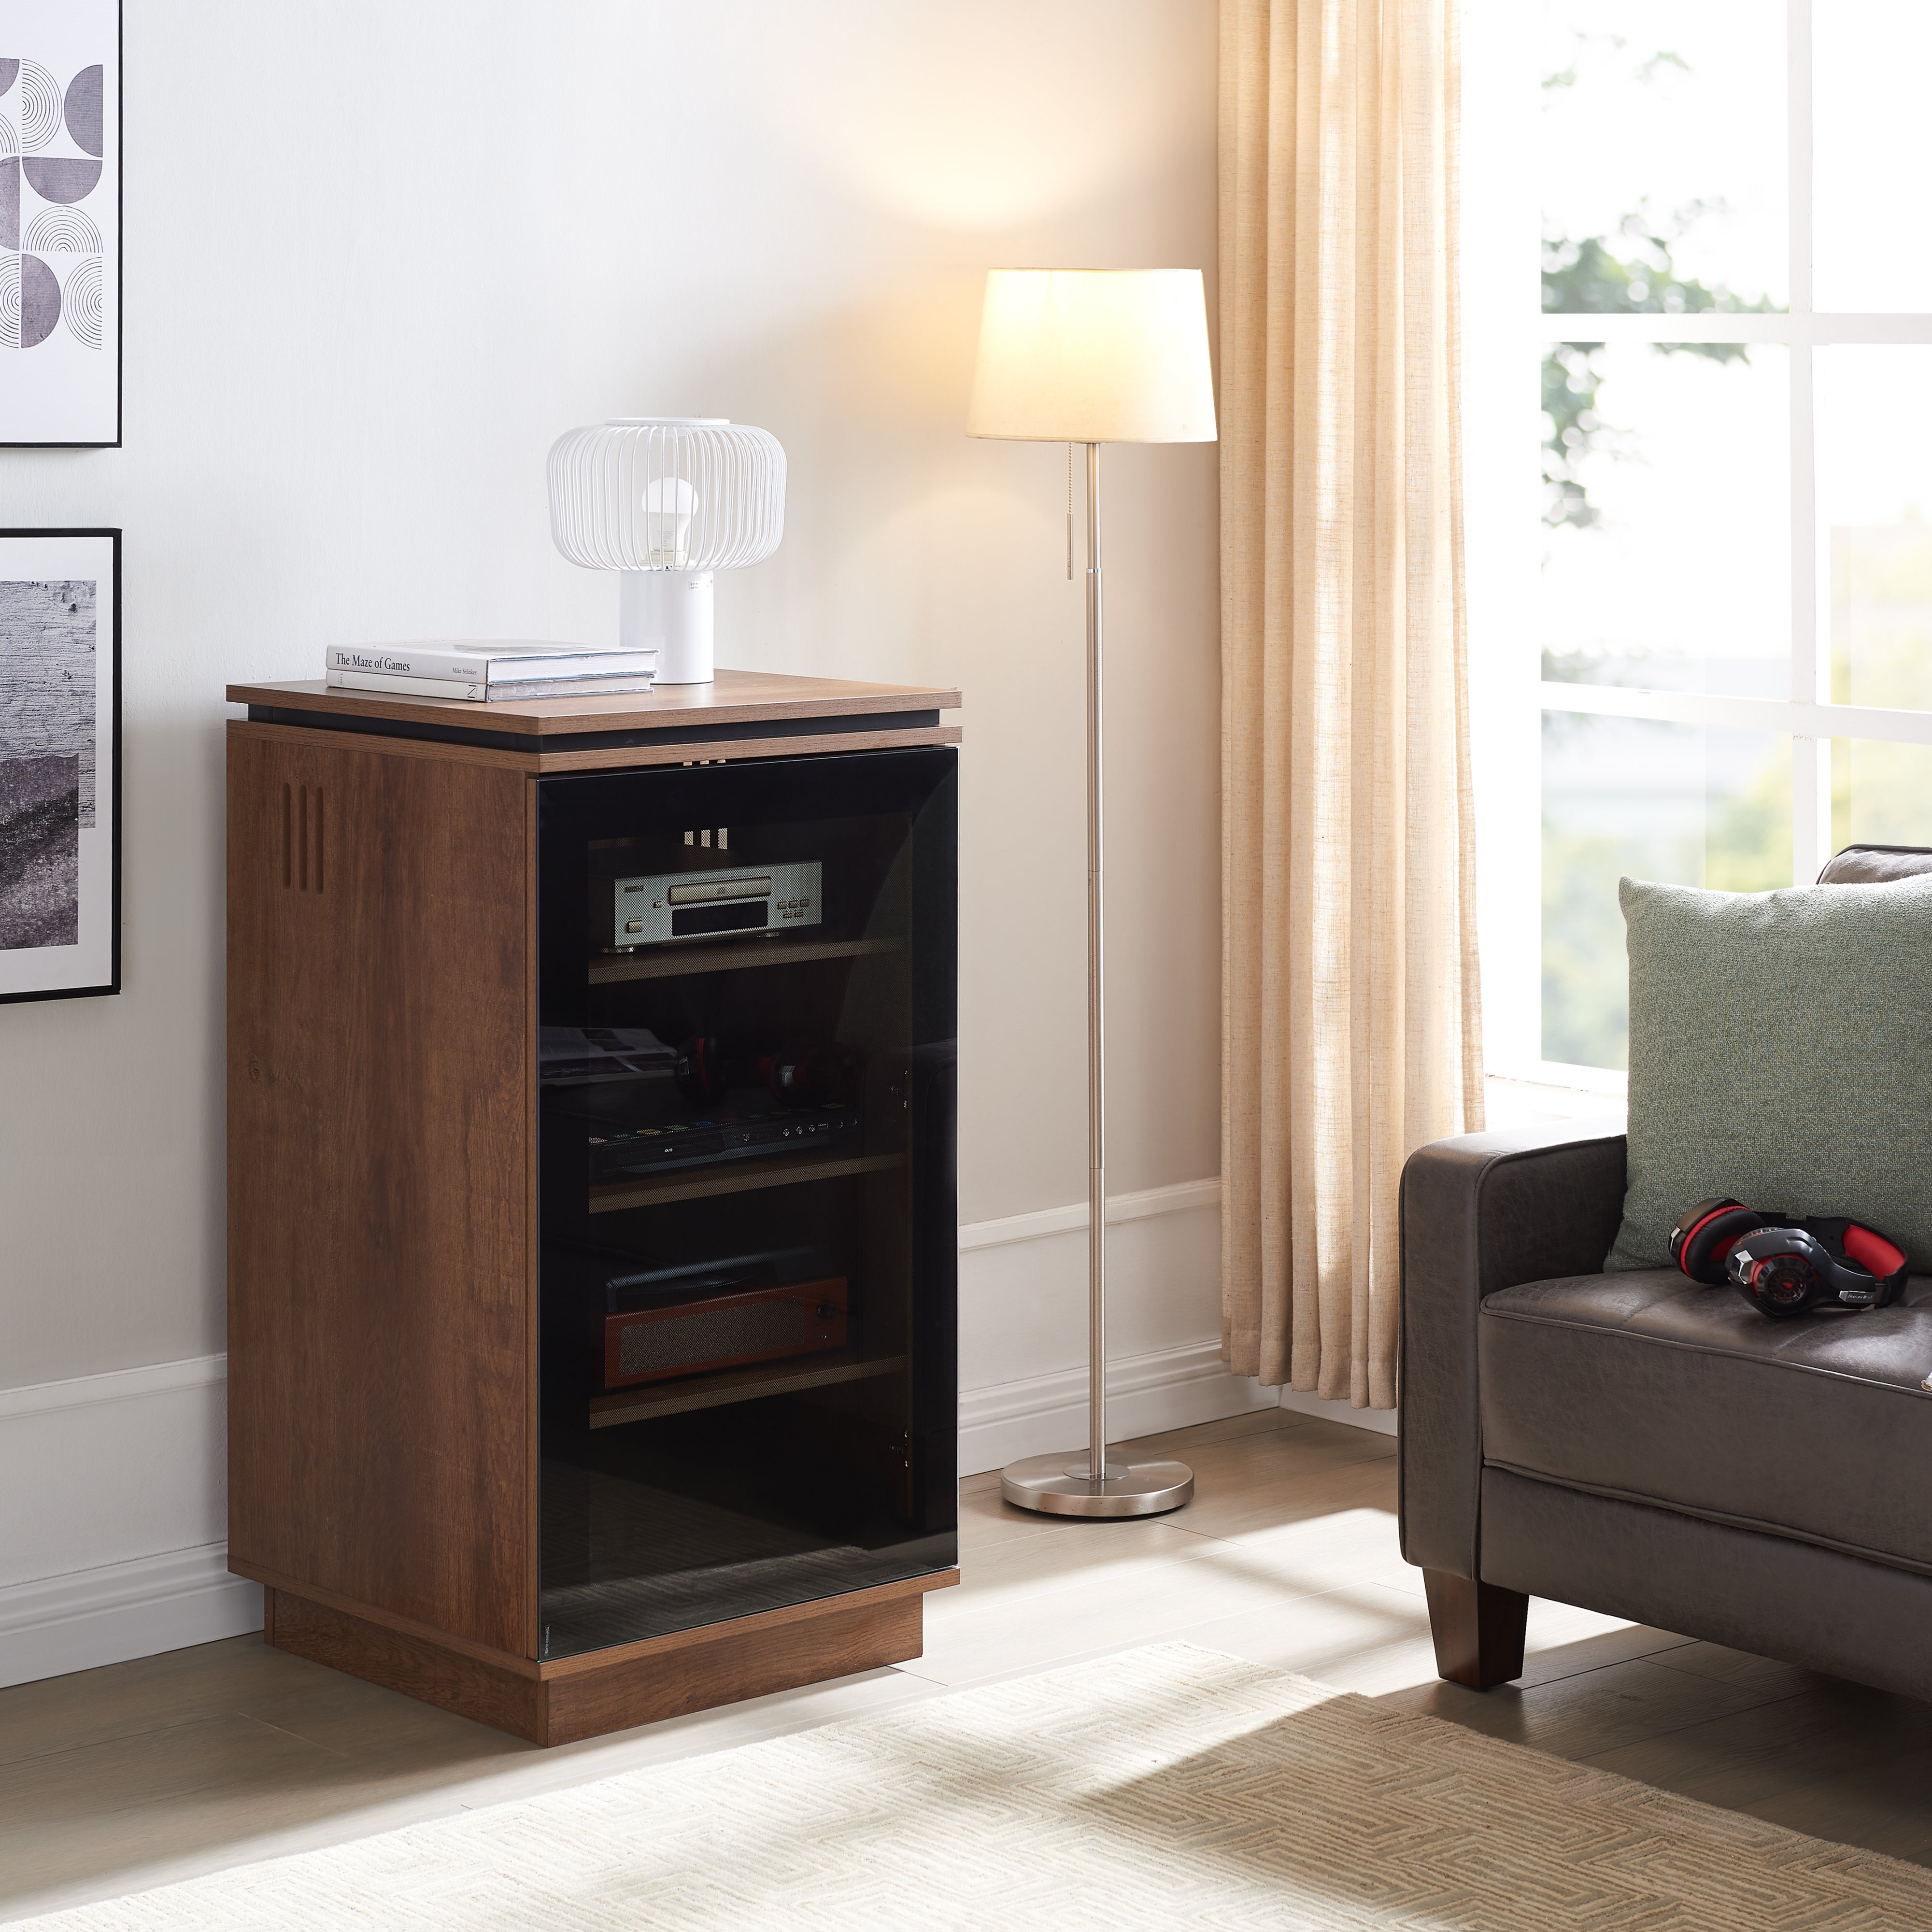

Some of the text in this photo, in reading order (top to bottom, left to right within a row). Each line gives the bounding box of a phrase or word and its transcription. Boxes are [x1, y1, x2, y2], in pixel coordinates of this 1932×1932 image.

[336, 653, 410, 671] The Maze of Games
